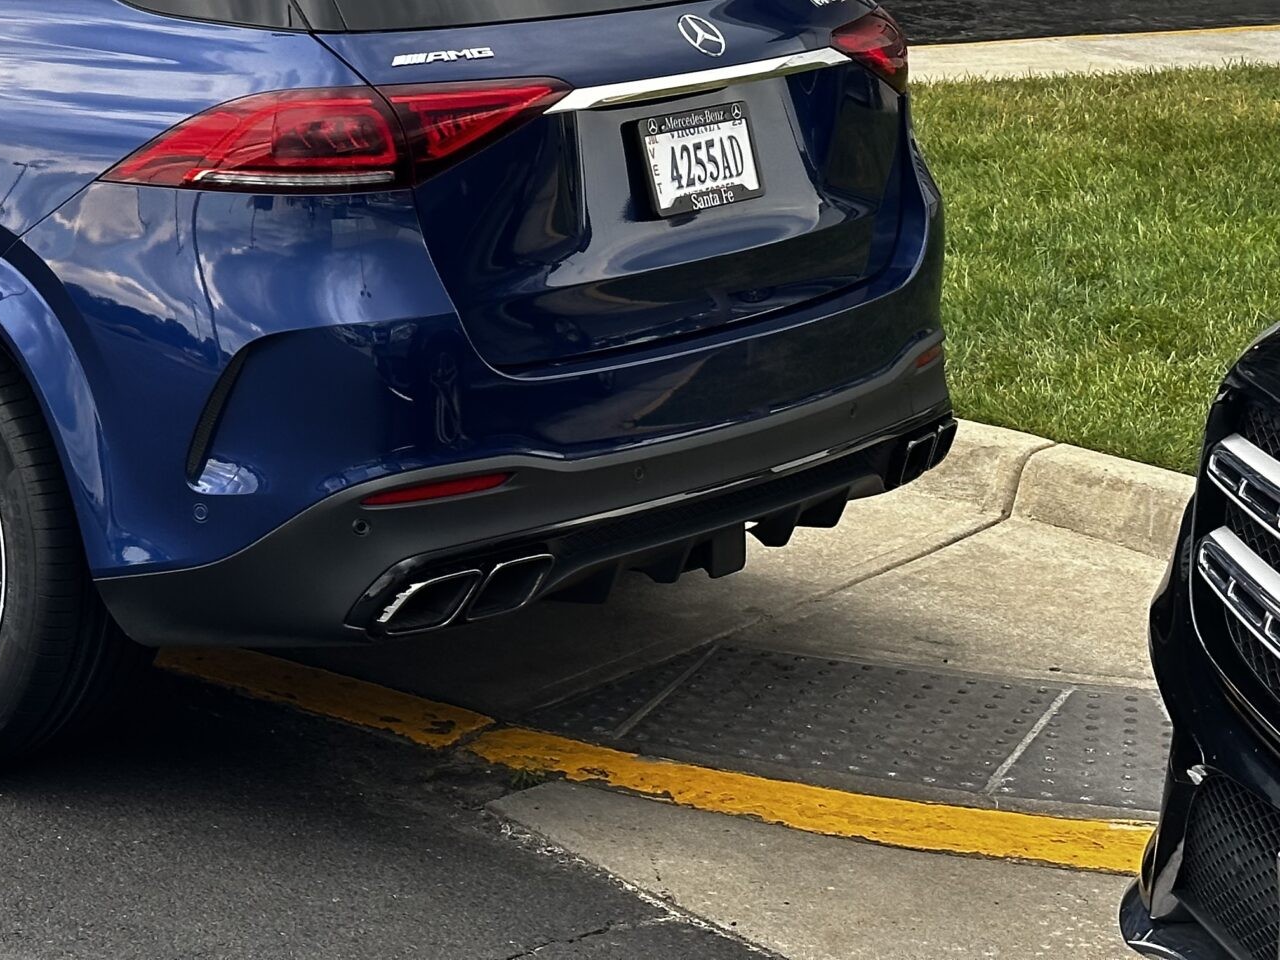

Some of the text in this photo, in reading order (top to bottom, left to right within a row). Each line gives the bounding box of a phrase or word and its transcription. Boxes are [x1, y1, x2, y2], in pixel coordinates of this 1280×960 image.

[661, 110, 724, 131] Mercedes-Benz
[670, 135, 744, 190] 4255AD
[691, 191, 721, 210] Santa
[721, 187, 735, 204] Fe
